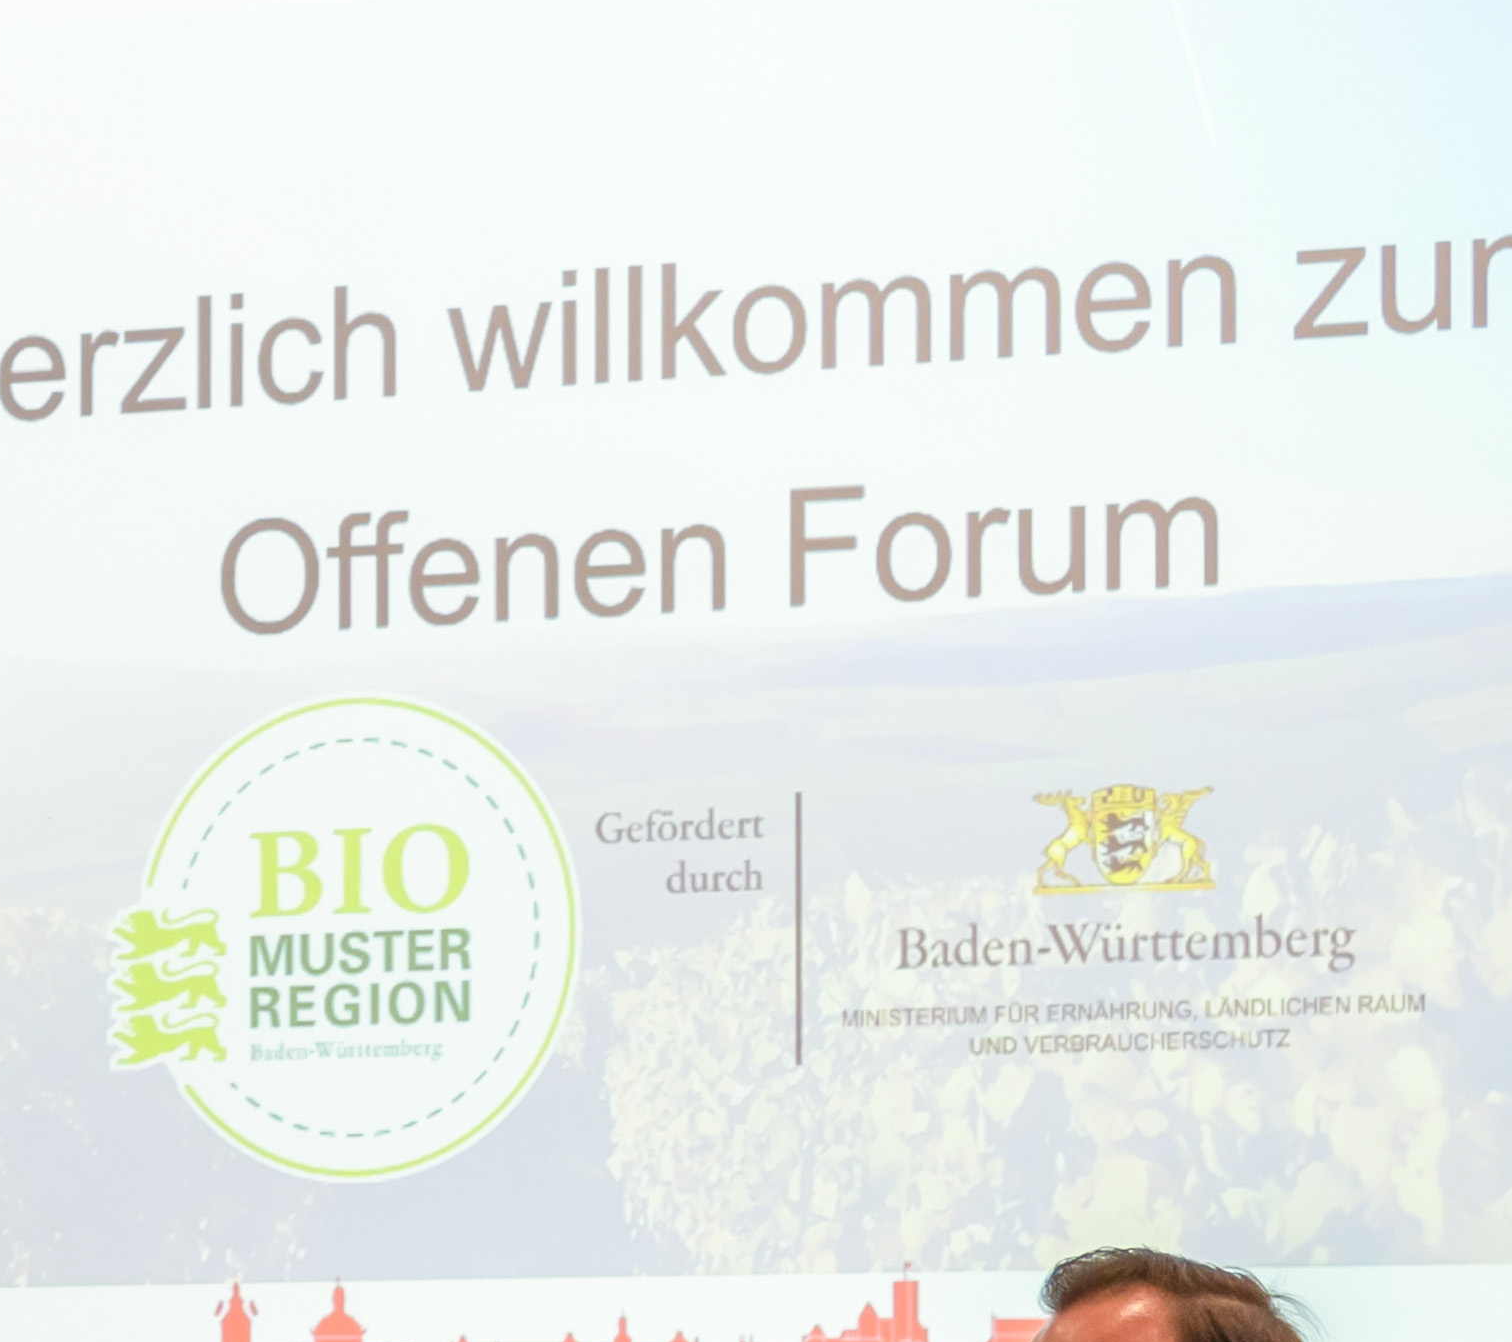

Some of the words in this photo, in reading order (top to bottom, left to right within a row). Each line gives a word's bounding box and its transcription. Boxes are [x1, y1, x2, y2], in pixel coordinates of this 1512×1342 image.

[448, 253, 1239, 393] willkommen
[219, 510, 727, 636] Offenen
[787, 484, 1221, 611] Forum
[595, 807, 764, 844] Gefördert
[249, 823, 470, 919] BIO
[666, 860, 763, 894] durch
[249, 928, 472, 978] MUSTER
[896, 913, 1357, 973] Baden-Württemberg
[249, 980, 472, 1029] REGION
[842, 1004, 988, 1028] MINISTERIUM
[994, 1000, 1039, 1025] FÜR
[1046, 998, 1198, 1024] ERNÄHRUNG,
[1204, 994, 1352, 1020] LÄNDLICHEN
[1358, 993, 1427, 1015] RAUM
[969, 1035, 1018, 1056] UND
[1024, 1029, 1291, 1054] VERBRAUCHERSCHUTZ
